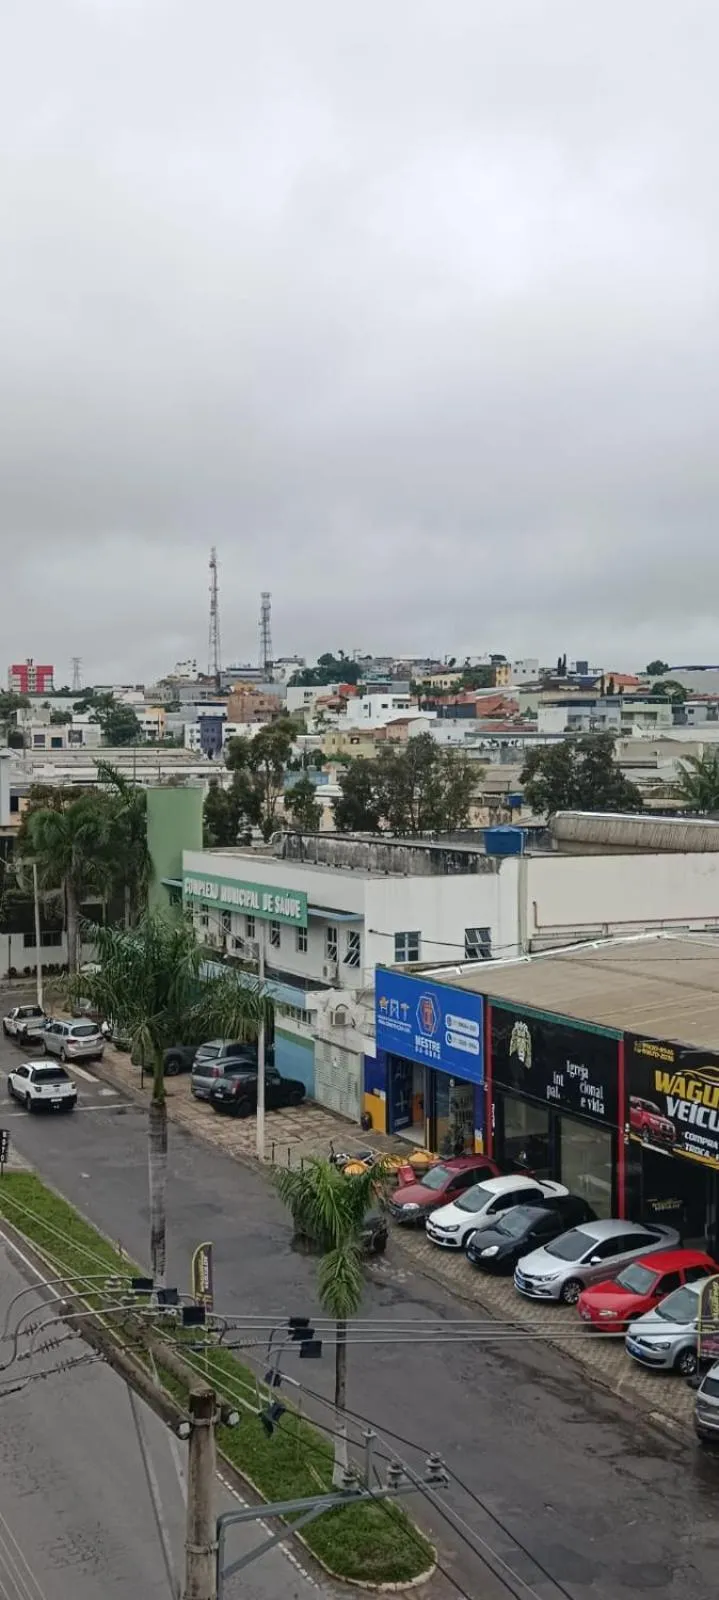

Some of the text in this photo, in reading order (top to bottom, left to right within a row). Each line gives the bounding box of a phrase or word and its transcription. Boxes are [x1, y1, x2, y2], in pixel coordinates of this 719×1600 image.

[220, 886, 260, 911] MUNICIPAL
[262, 892, 275, 913] DE
[275, 892, 301, 919] SAÚDE
[415, 1034, 441, 1054] MESTRE
[566, 1059, 589, 1080] Igreja
[587, 1097, 605, 1114] vida
[684, 1131, 718, 1150] COMPRA
